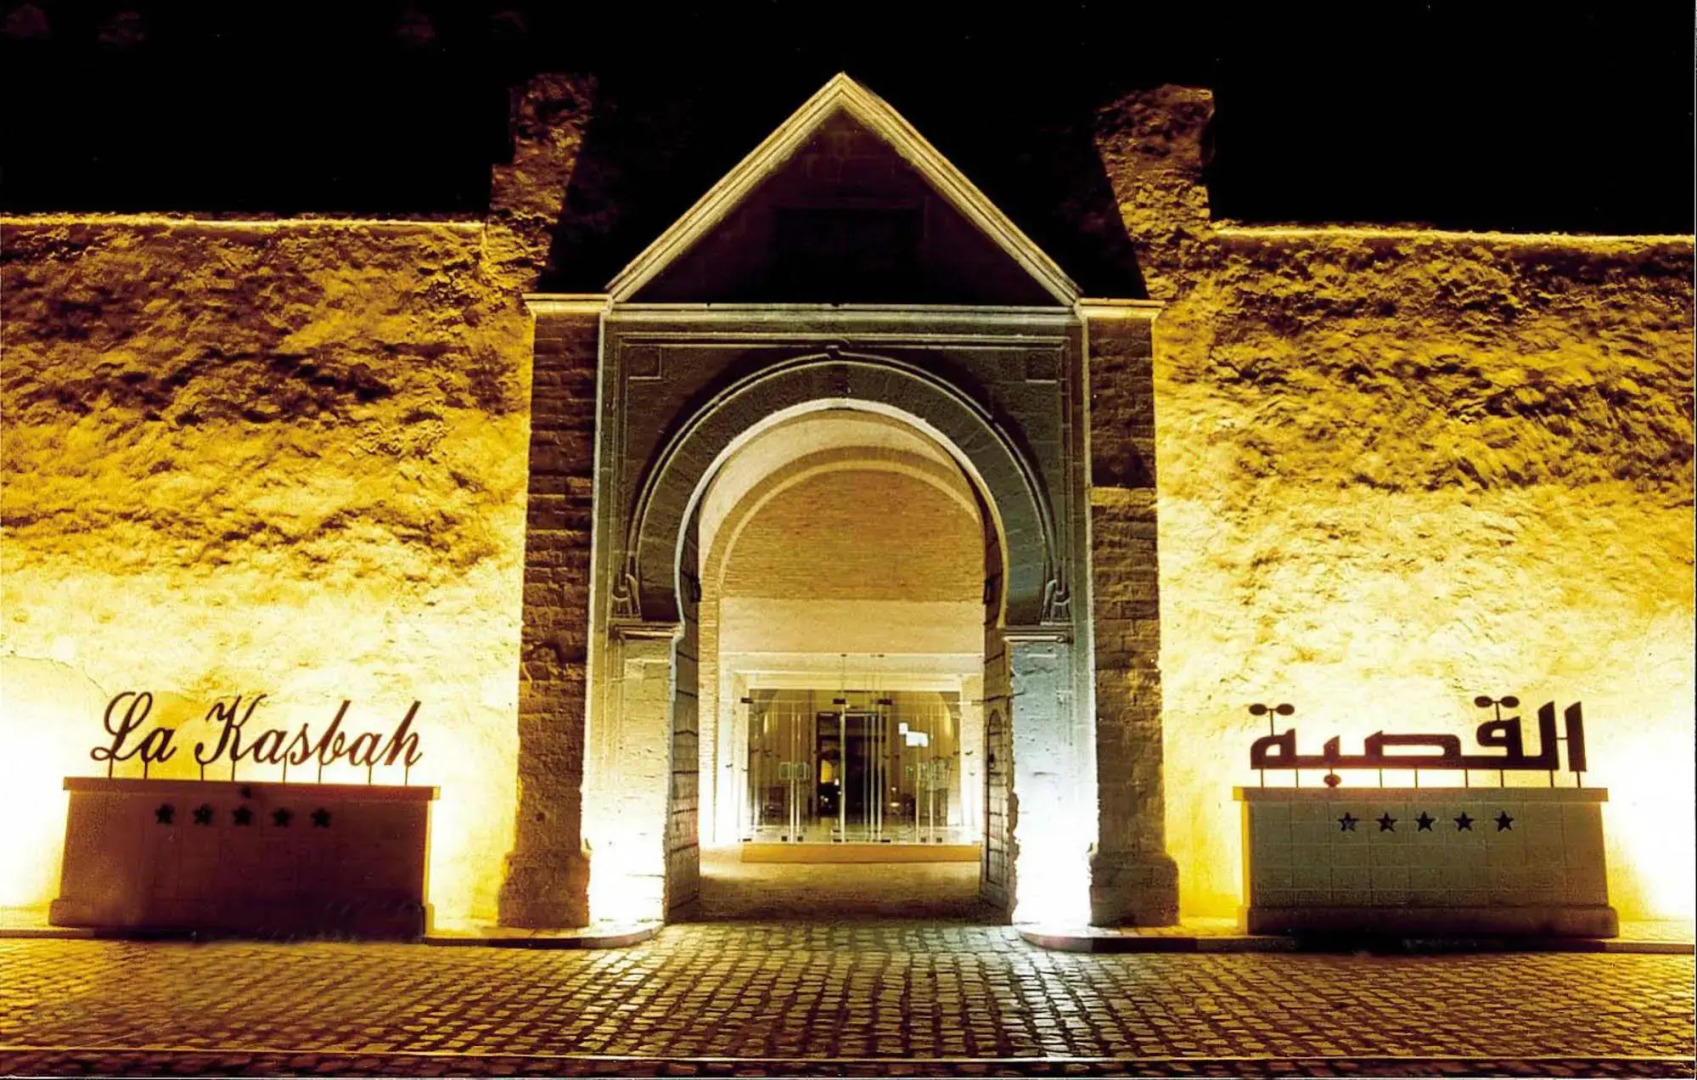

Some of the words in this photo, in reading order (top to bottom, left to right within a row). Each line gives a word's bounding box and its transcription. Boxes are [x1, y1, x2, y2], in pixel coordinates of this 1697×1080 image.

[90, 691, 177, 763] La
[194, 694, 422, 766] Kasbah
[1248, 695, 1587, 787] القصبة
